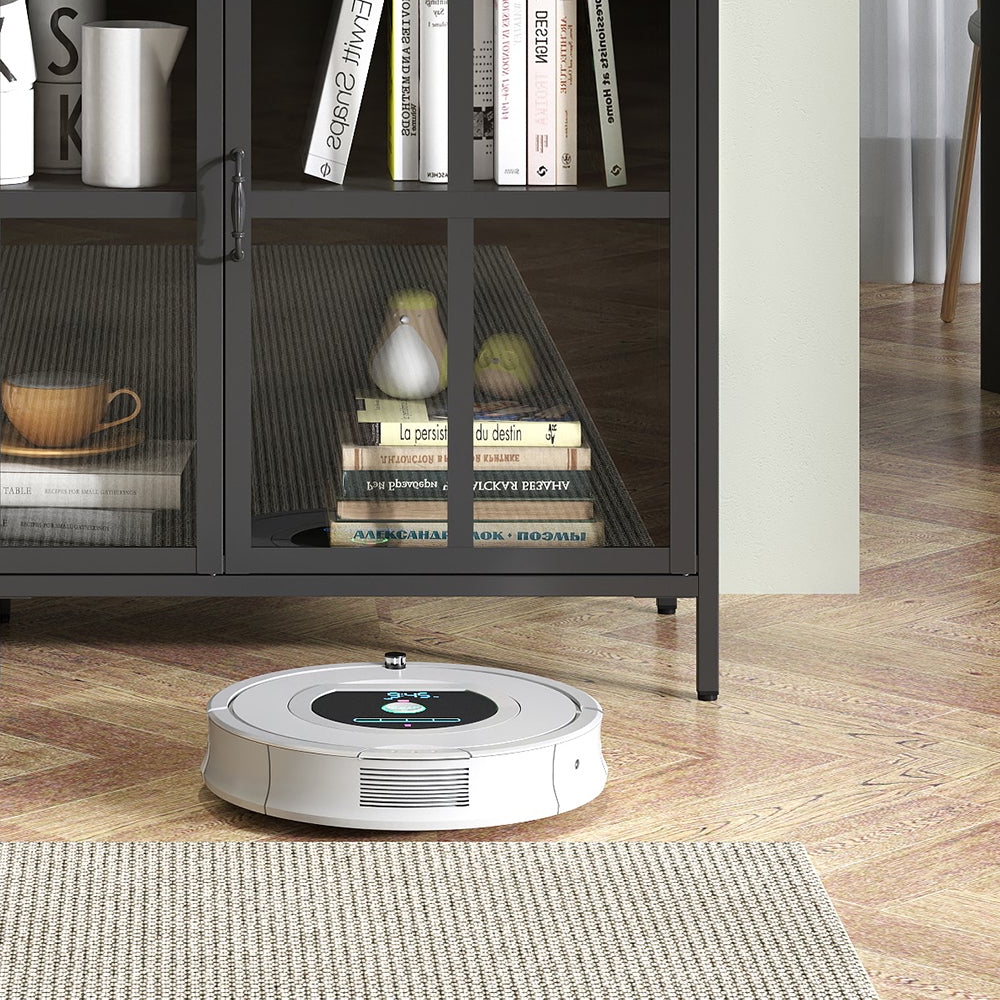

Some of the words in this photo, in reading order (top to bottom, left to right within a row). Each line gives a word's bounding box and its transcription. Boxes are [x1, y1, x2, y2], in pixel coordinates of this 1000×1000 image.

[47, 6, 79, 76] S
[59, 94, 82, 161] K
[400, 422, 411, 441] La
[414, 424, 448, 444] persist
[475, 424, 489, 441] du
[492, 424, 522, 441] destin
[2, 486, 32, 495] TABLE
[473, 531, 505, 541] ЛОК
[517, 531, 587, 541] ПОЭМЫ
